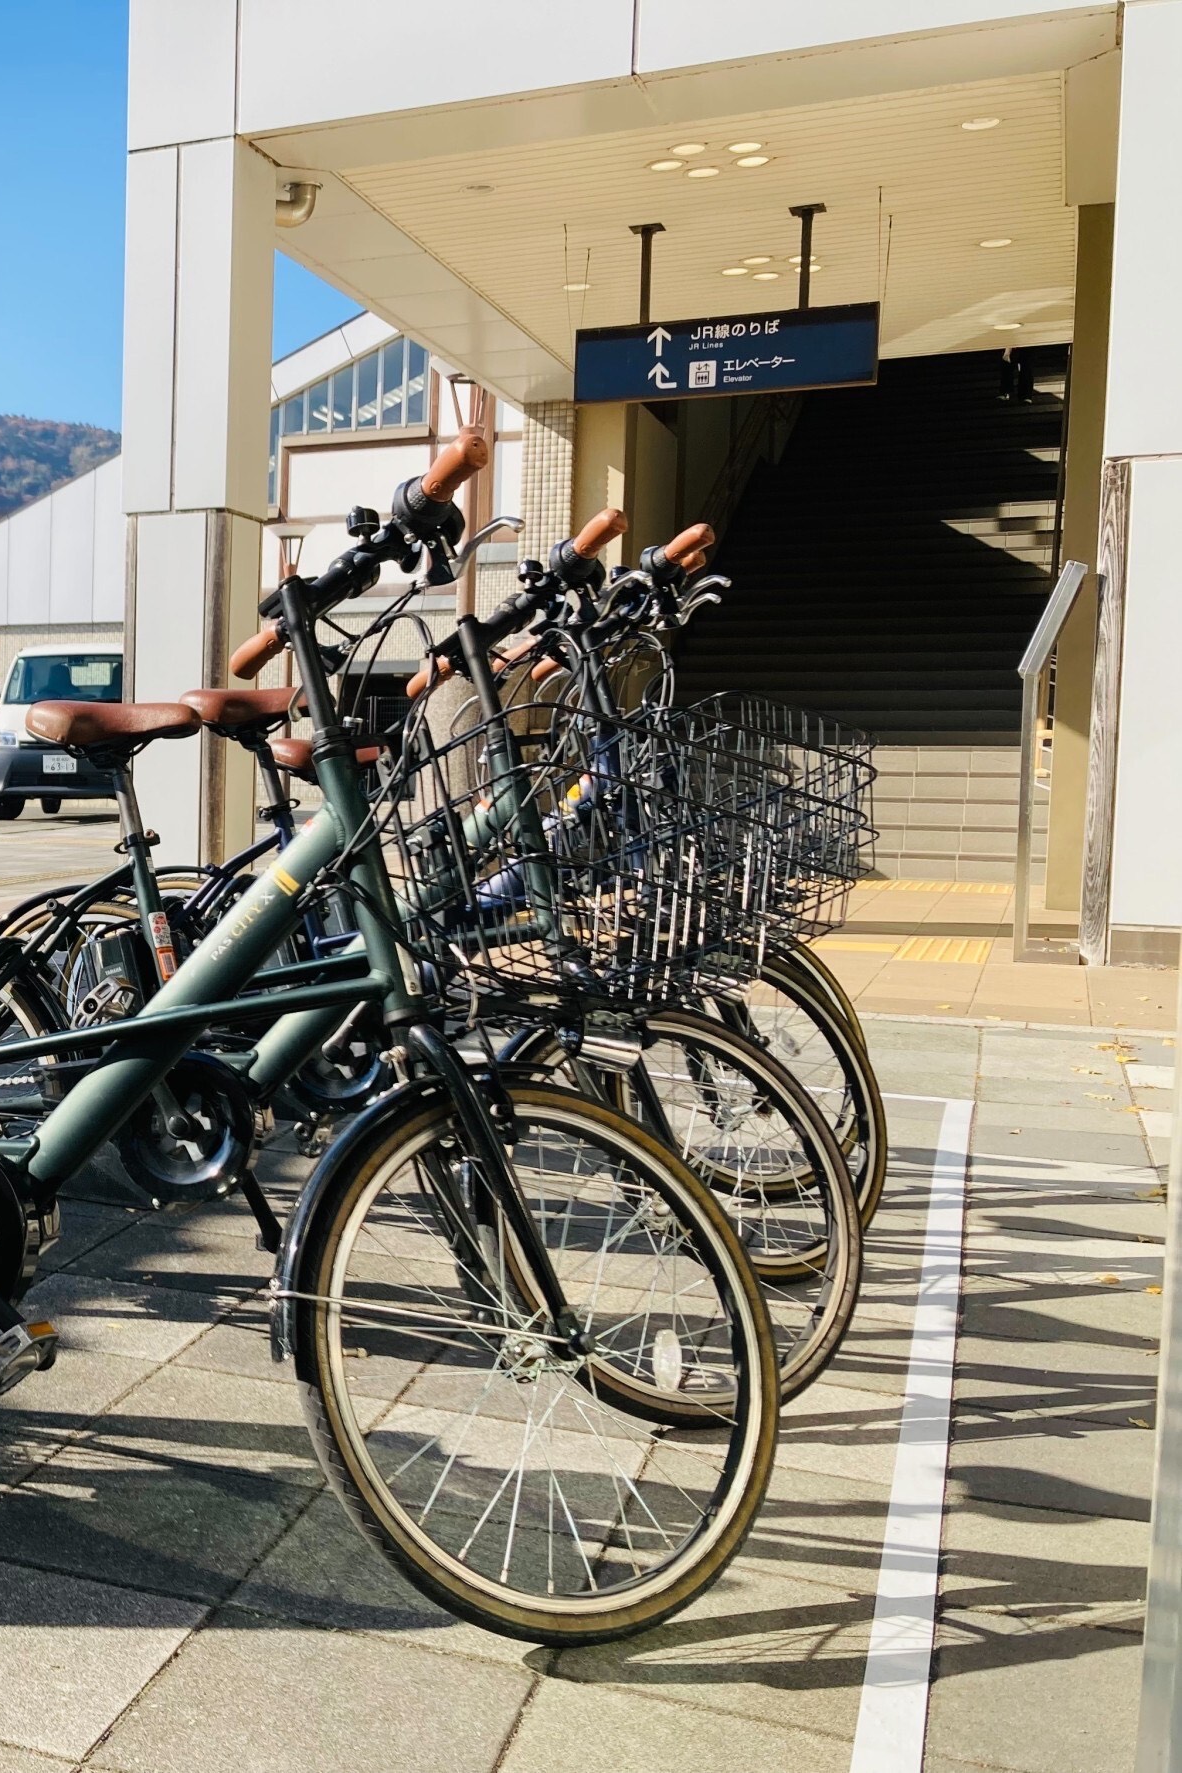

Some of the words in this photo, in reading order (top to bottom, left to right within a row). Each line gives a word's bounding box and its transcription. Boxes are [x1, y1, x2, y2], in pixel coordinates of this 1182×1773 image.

[690, 319, 780, 340] JR線のりば
[723, 355, 795, 371] エレベーター
[723, 375, 752, 383] Elevator
[210, 938, 232, 961] PAS
[261, 891, 275, 905] X
